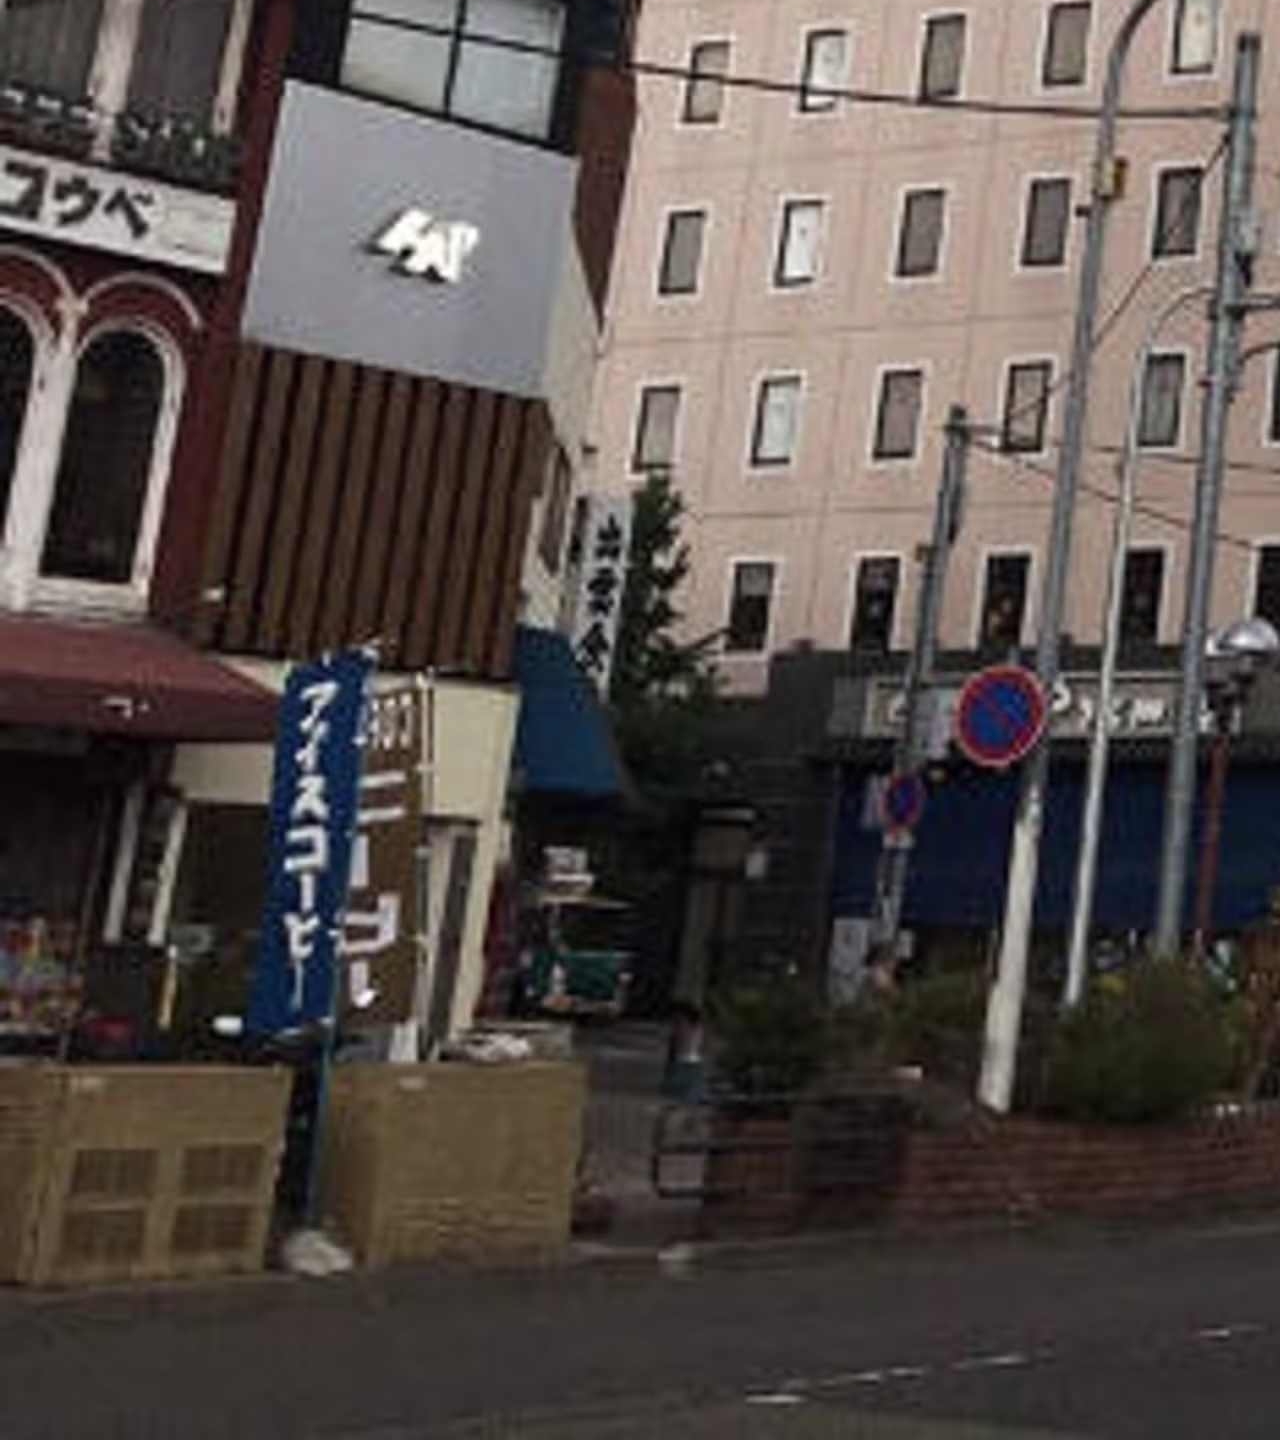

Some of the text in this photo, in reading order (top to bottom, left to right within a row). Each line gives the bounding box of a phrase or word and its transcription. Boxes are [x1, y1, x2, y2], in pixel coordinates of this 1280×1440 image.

[0, 161, 155, 240] コウベ
[282, 680, 340, 1008] アイスコーヒー
